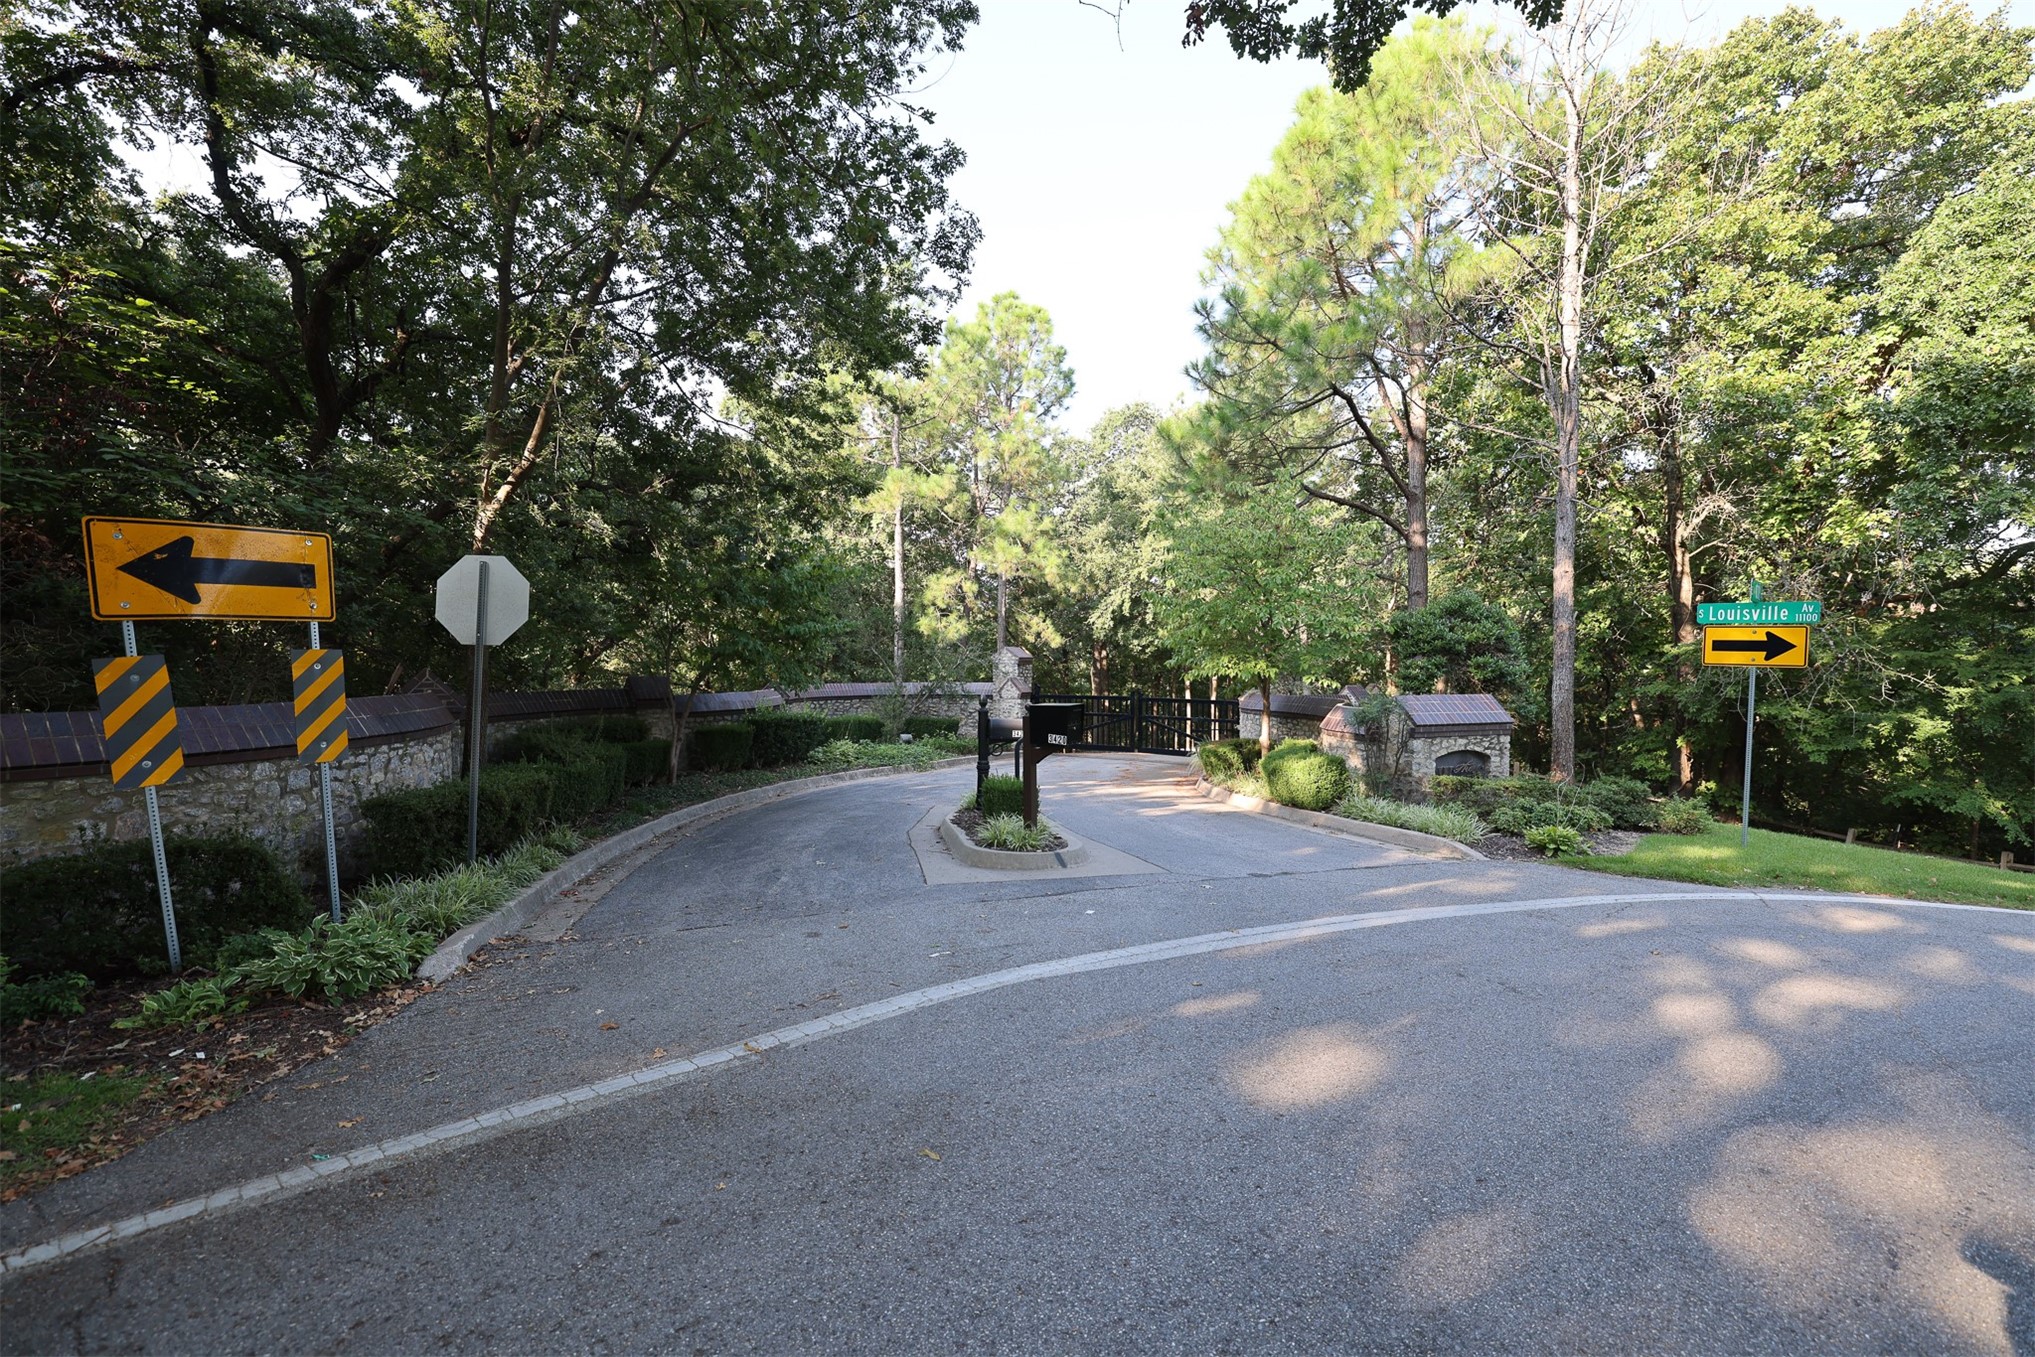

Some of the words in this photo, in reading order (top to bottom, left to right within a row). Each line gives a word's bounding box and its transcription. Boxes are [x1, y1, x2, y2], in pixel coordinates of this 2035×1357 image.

[1698, 609, 1704, 618] S
[1709, 605, 1788, 621] Louisville
[1795, 613, 1818, 622] 11100
